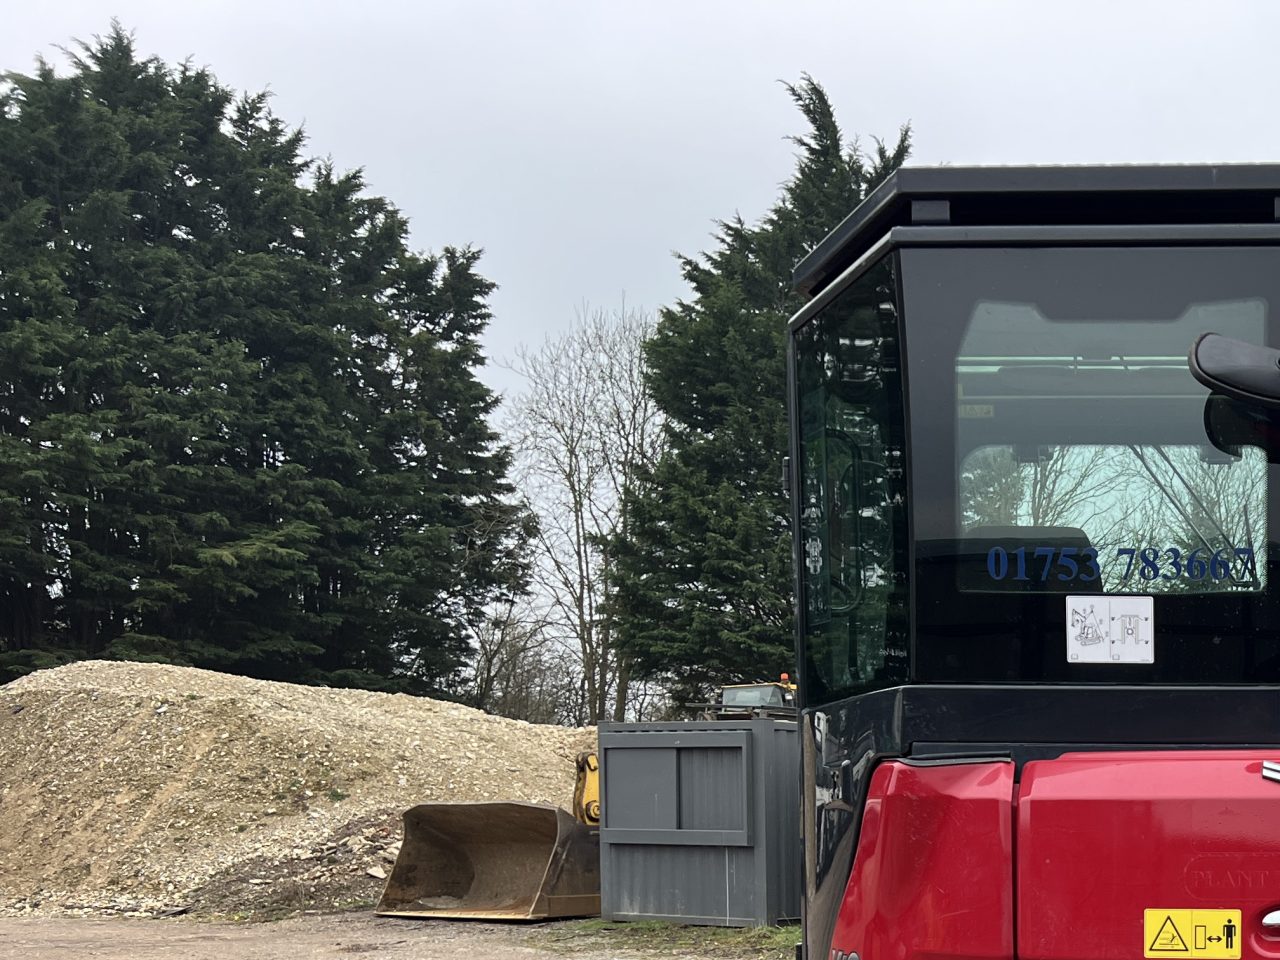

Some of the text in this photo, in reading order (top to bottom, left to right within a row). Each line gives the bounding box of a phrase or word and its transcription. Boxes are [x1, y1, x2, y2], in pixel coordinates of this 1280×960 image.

[986, 546, 1256, 582] 01753 783667
[1191, 869, 1271, 889] PLANT
